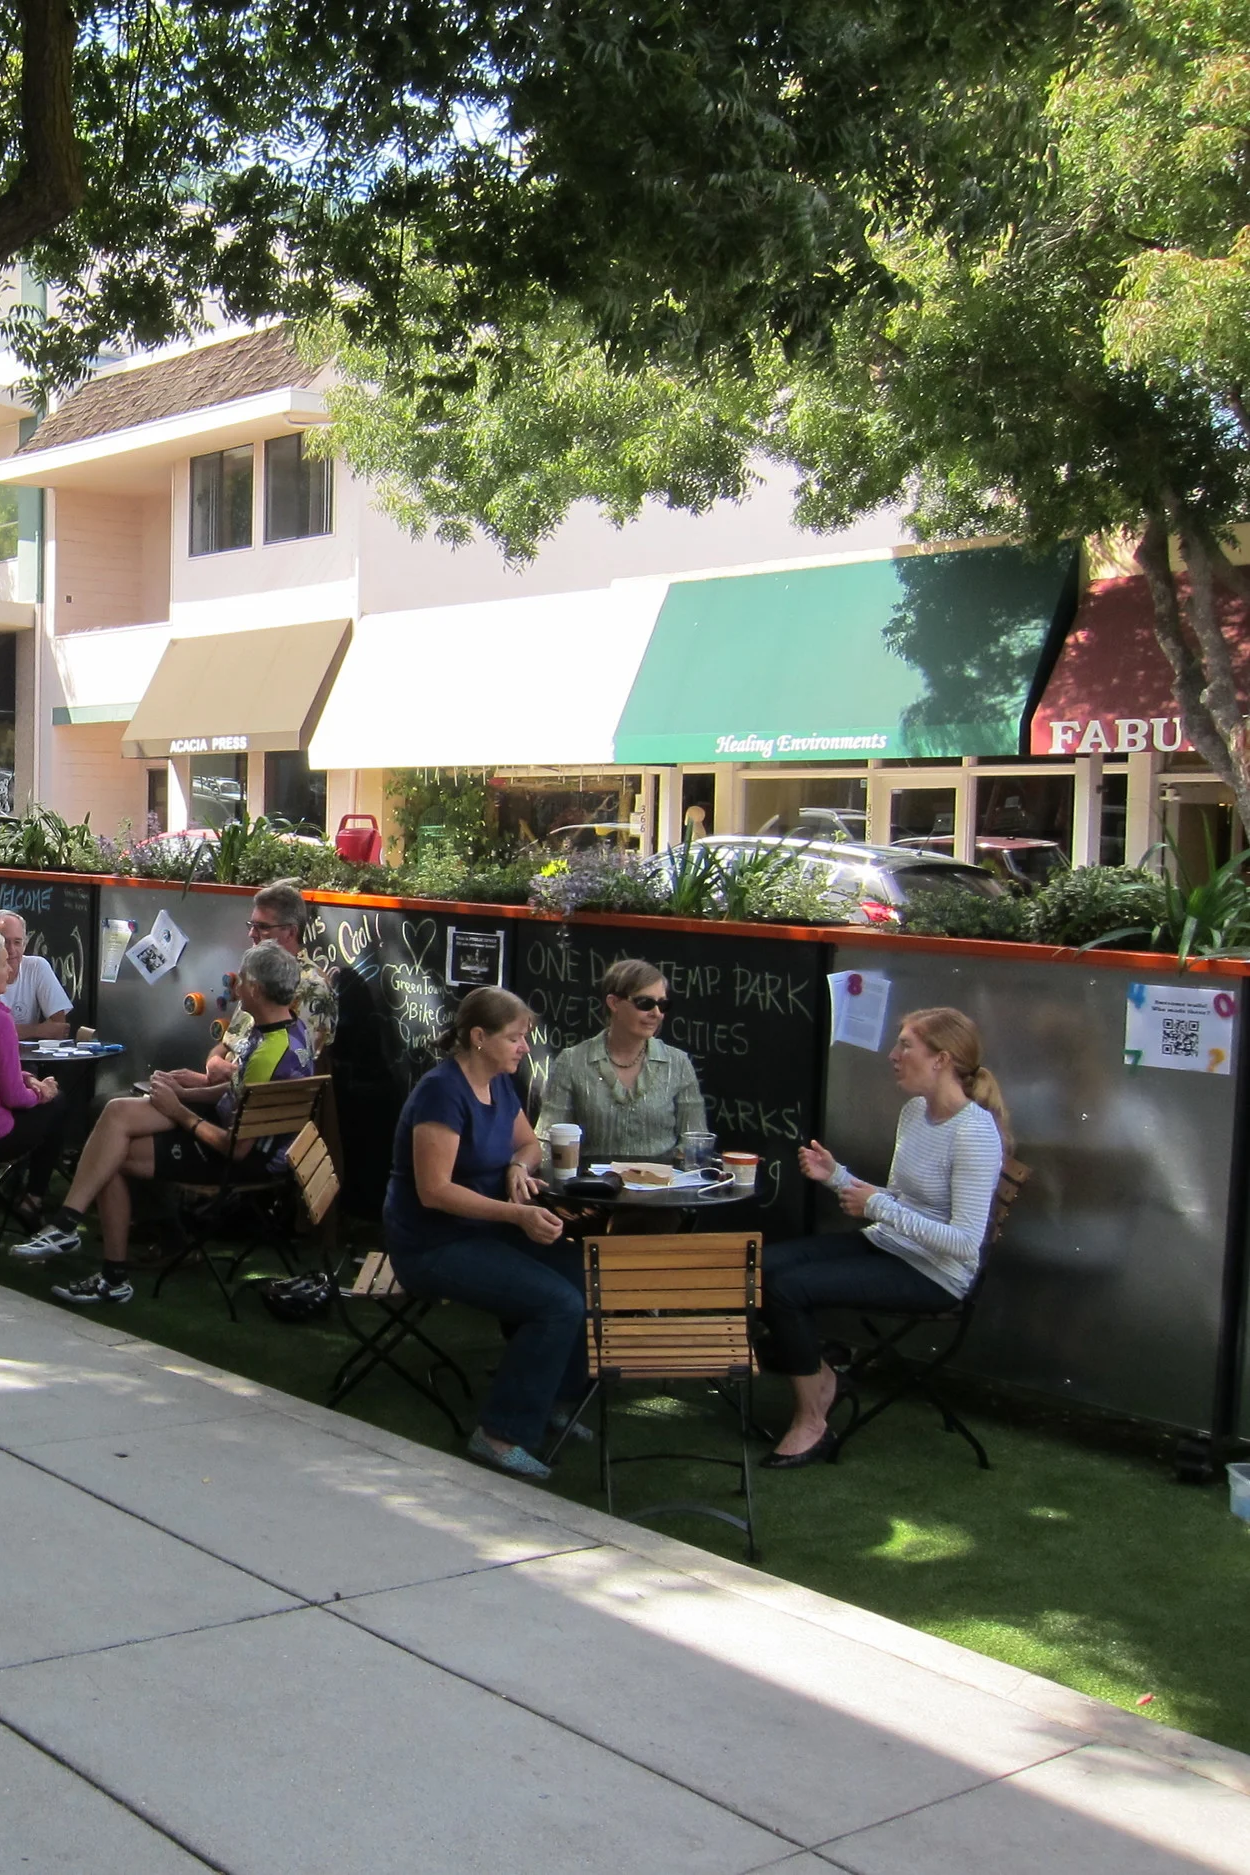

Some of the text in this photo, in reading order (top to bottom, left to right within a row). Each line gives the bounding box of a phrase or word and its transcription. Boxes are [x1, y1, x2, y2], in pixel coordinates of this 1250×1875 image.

[169, 736, 247, 754] ACACIA PRESS
[715, 732, 888, 759] Healing Environments
[1048, 717, 1195, 754] FABU
[526, 940, 583, 983] ONE
[732, 962, 814, 1023] PARK
[409, 1001, 435, 1026] Bike
[527, 988, 749, 1056] OVER CITIES
